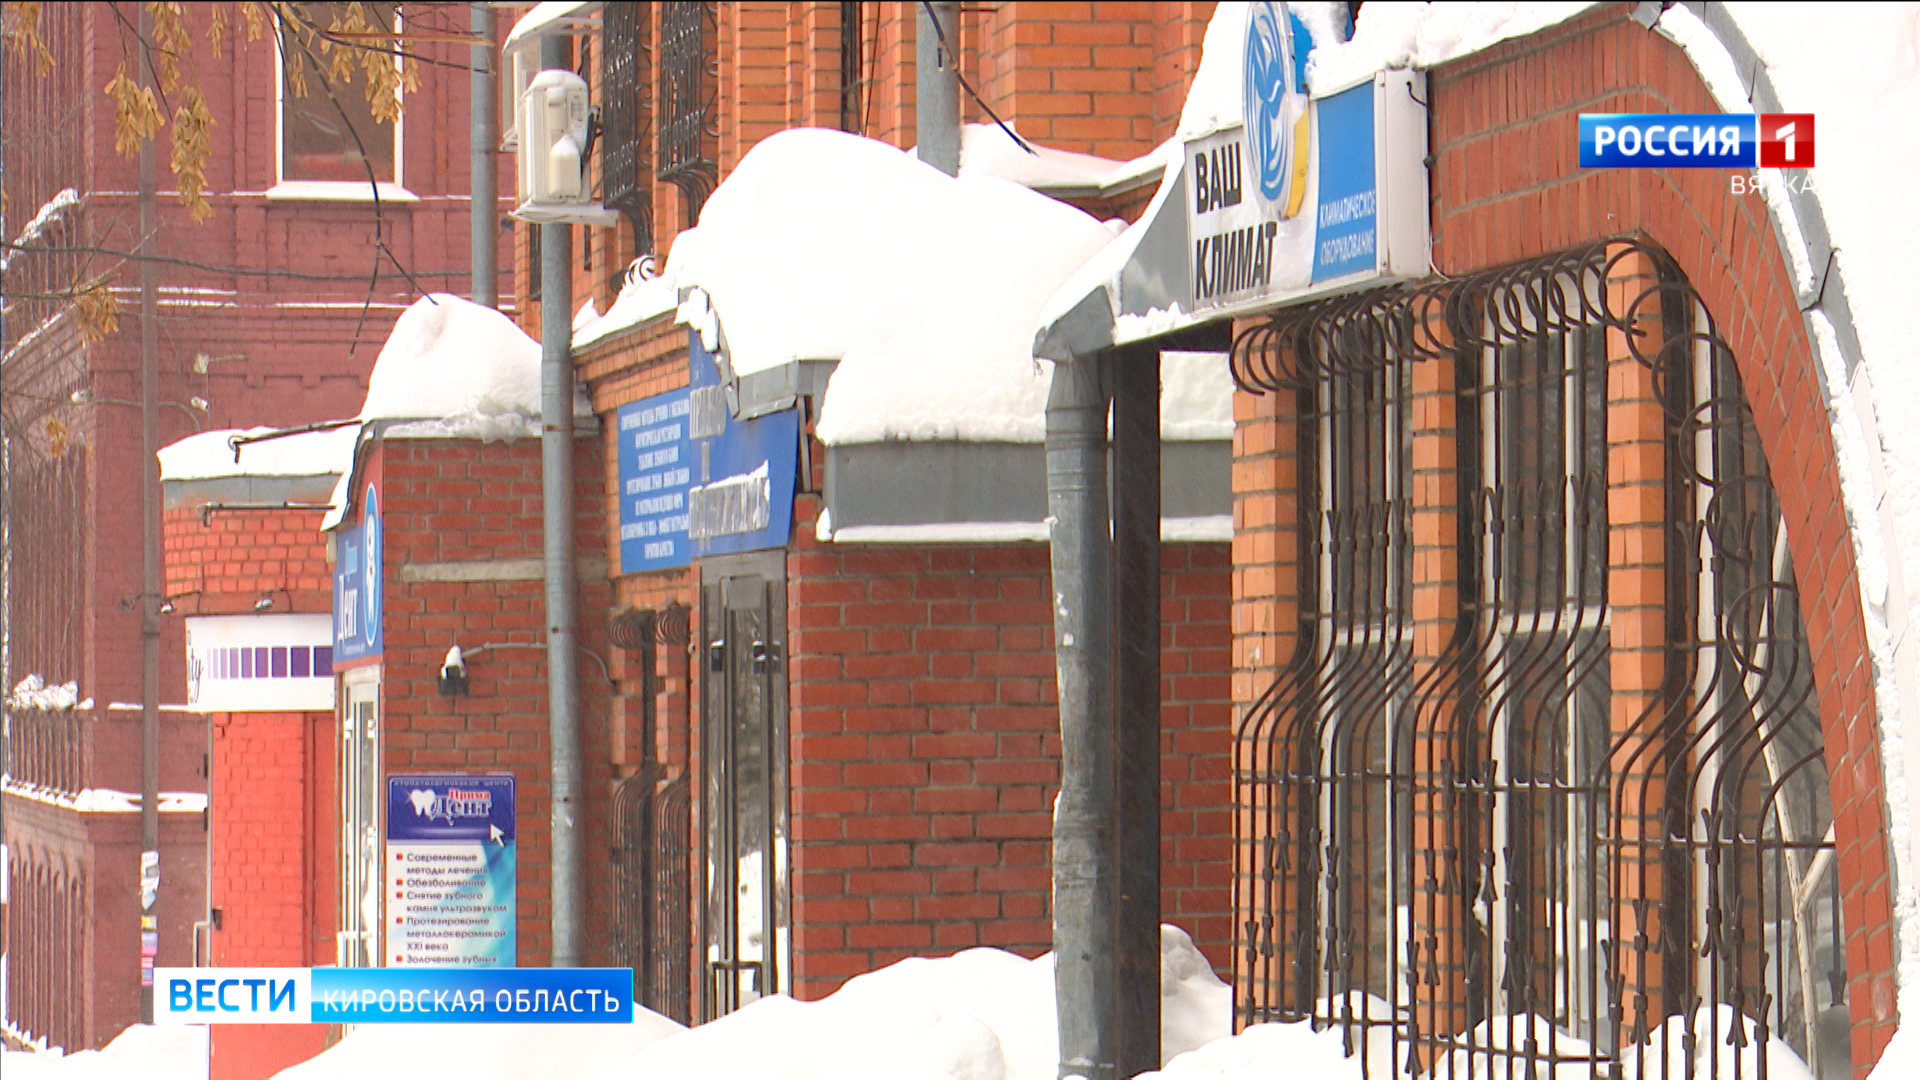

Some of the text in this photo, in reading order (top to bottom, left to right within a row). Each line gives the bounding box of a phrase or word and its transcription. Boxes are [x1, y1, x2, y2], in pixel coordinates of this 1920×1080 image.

[1195, 141, 1242, 215] ВАШ
[1320, 229, 1375, 266] ОБОРУДОВАНИЕ
[1196, 221, 1277, 299] КЛИМАТ
[407, 853, 478, 862] Современные
[407, 867, 446, 875] методы
[407, 878, 486, 887] Обезболивание
[407, 890, 483, 900] Снятие зубного
[407, 917, 490, 926] Протезирование
[407, 930, 506, 939] металлокерамикой
[407, 954, 460, 963] Золочение
